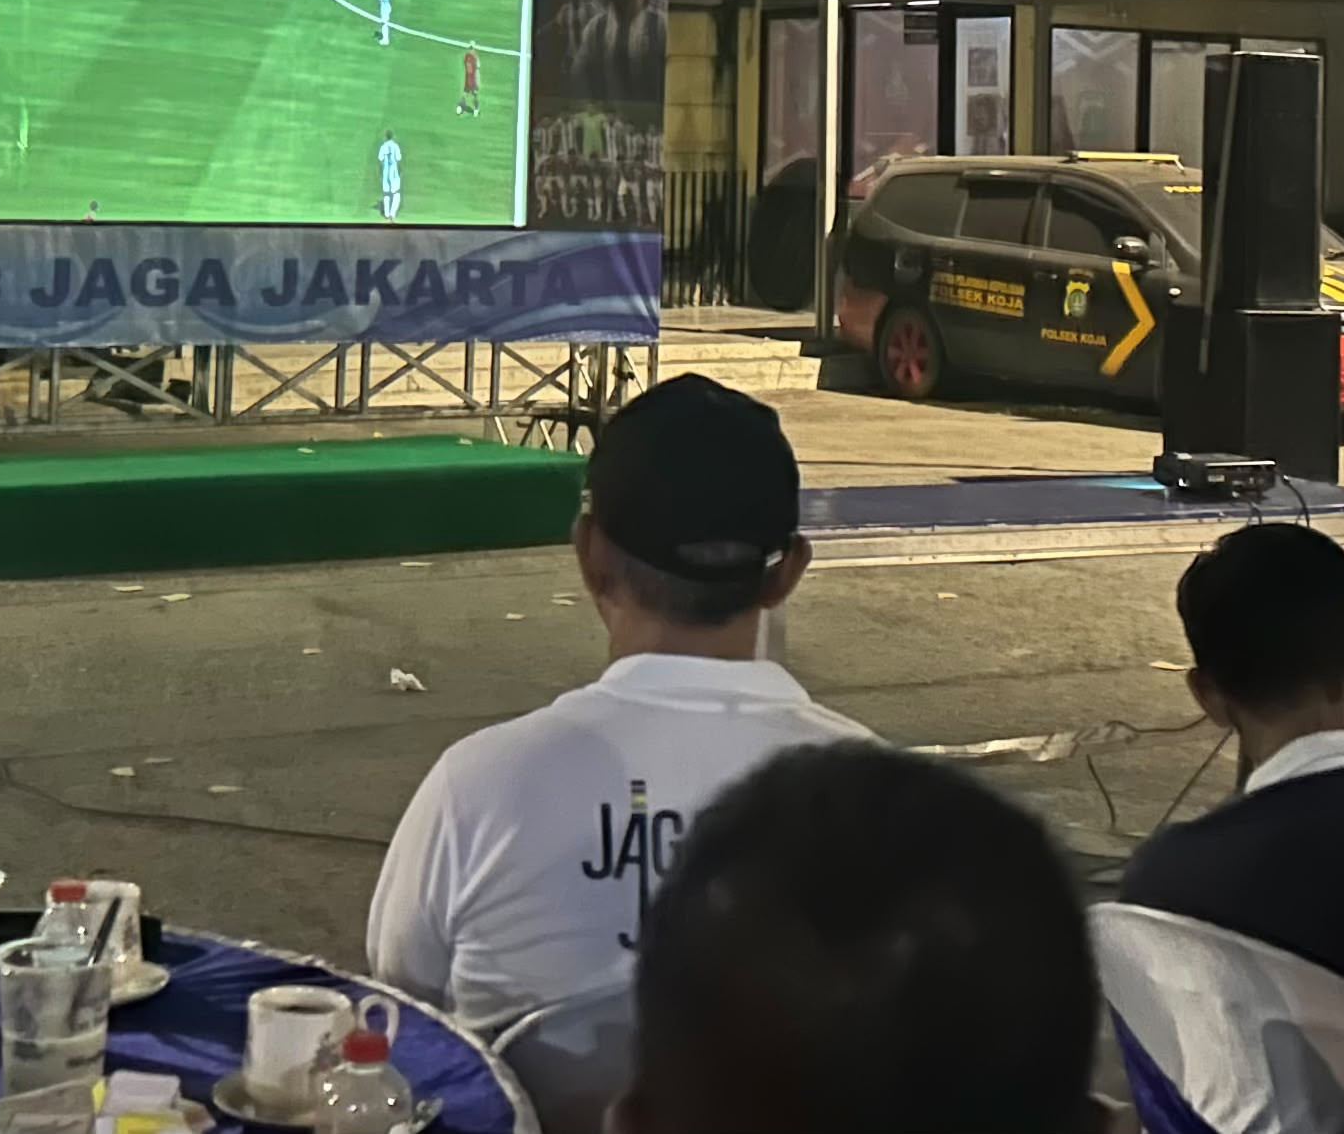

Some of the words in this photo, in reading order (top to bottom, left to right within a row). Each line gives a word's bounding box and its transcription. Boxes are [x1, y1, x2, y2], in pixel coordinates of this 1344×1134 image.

[29, 256, 238, 308] JAGA
[260, 256, 581, 308] JAKARTA
[987, 292, 1024, 311] KOJA
